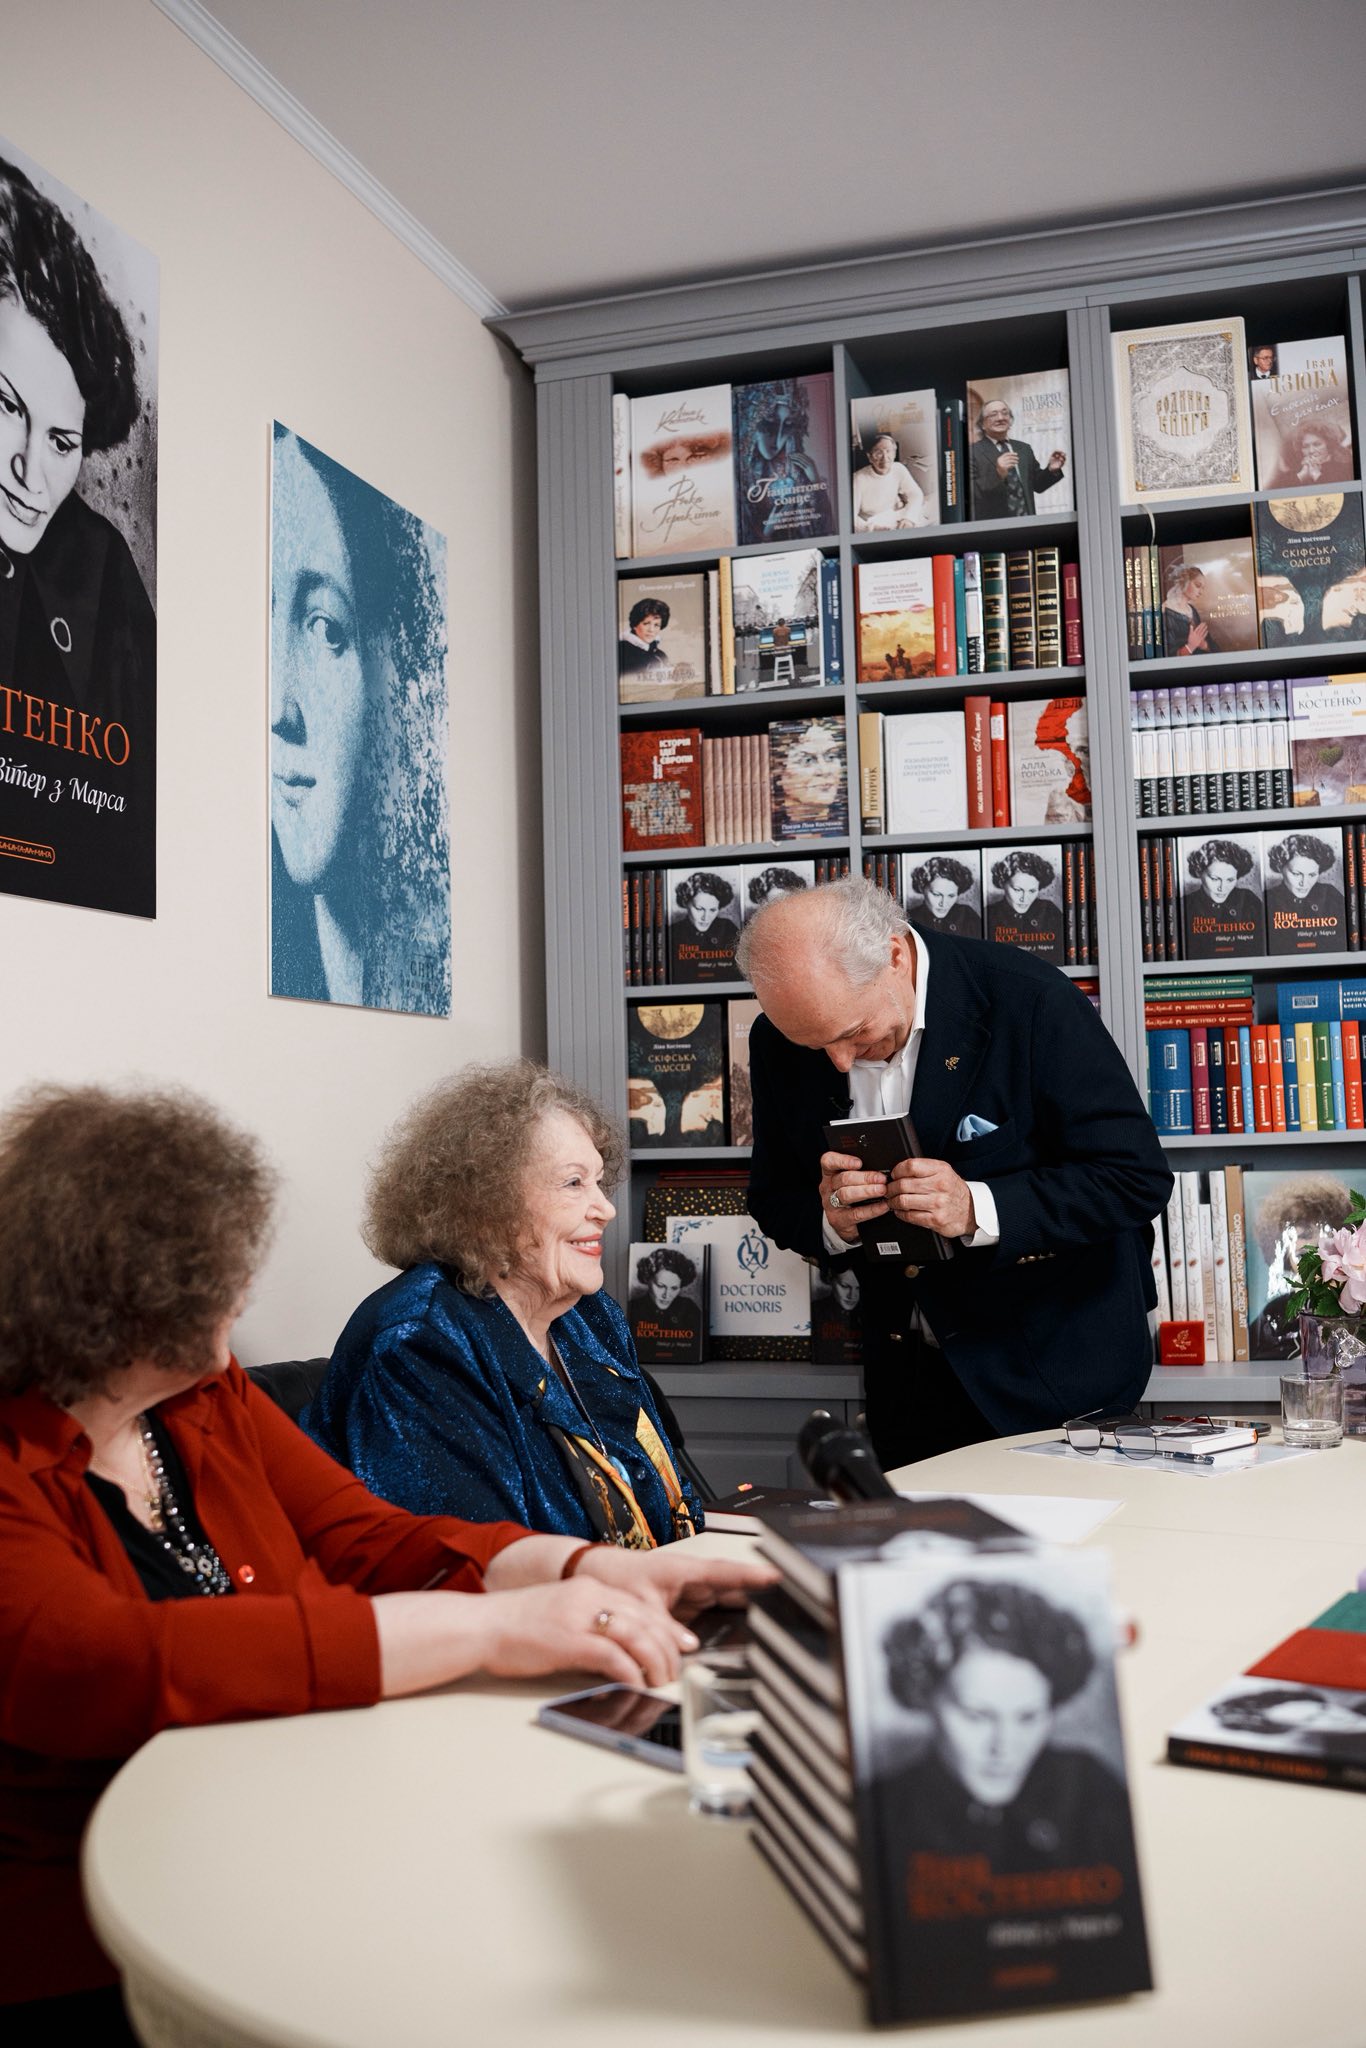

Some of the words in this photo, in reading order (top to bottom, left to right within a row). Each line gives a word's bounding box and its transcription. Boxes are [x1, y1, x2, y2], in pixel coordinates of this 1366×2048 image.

[1269, 369, 1339, 395] ДЗЮБА
[1281, 545, 1338, 559] СКІФСЬКА
[1289, 556, 1332, 568] ОДІССЕЯ
[1298, 696, 1362, 710] КОСТЕНКО
[0, 685, 130, 766] ТЕНКО
[1021, 761, 1047, 770] АЛЛА
[1021, 768, 1062, 778] ГОРСЬКА
[48, 779, 66, 803] з
[69, 777, 127, 814] Марса
[1192, 916, 1216, 925] Ліна
[1273, 911, 1298, 921] Ліна
[1193, 921, 1255, 934] КОСТЕНКО
[1273, 917, 1338, 930] КОСТЕНКО
[995, 932, 1056, 943] КОСТЕНКО
[678, 950, 734, 960] КОСТЕНКО
[648, 1053, 697, 1064] СКІФСЬКА
[654, 1063, 692, 1073] ОДІССЕЯ
[1233, 1213, 1244, 1280] CONTEMPORARY
[720, 1284, 787, 1297] DOCTORIS
[1237, 1281, 1246, 1312] SACRED
[724, 1301, 783, 1314] HONORIS
[1239, 1313, 1248, 1329] ART
[636, 1328, 694, 1339] КОСТЕНКО
